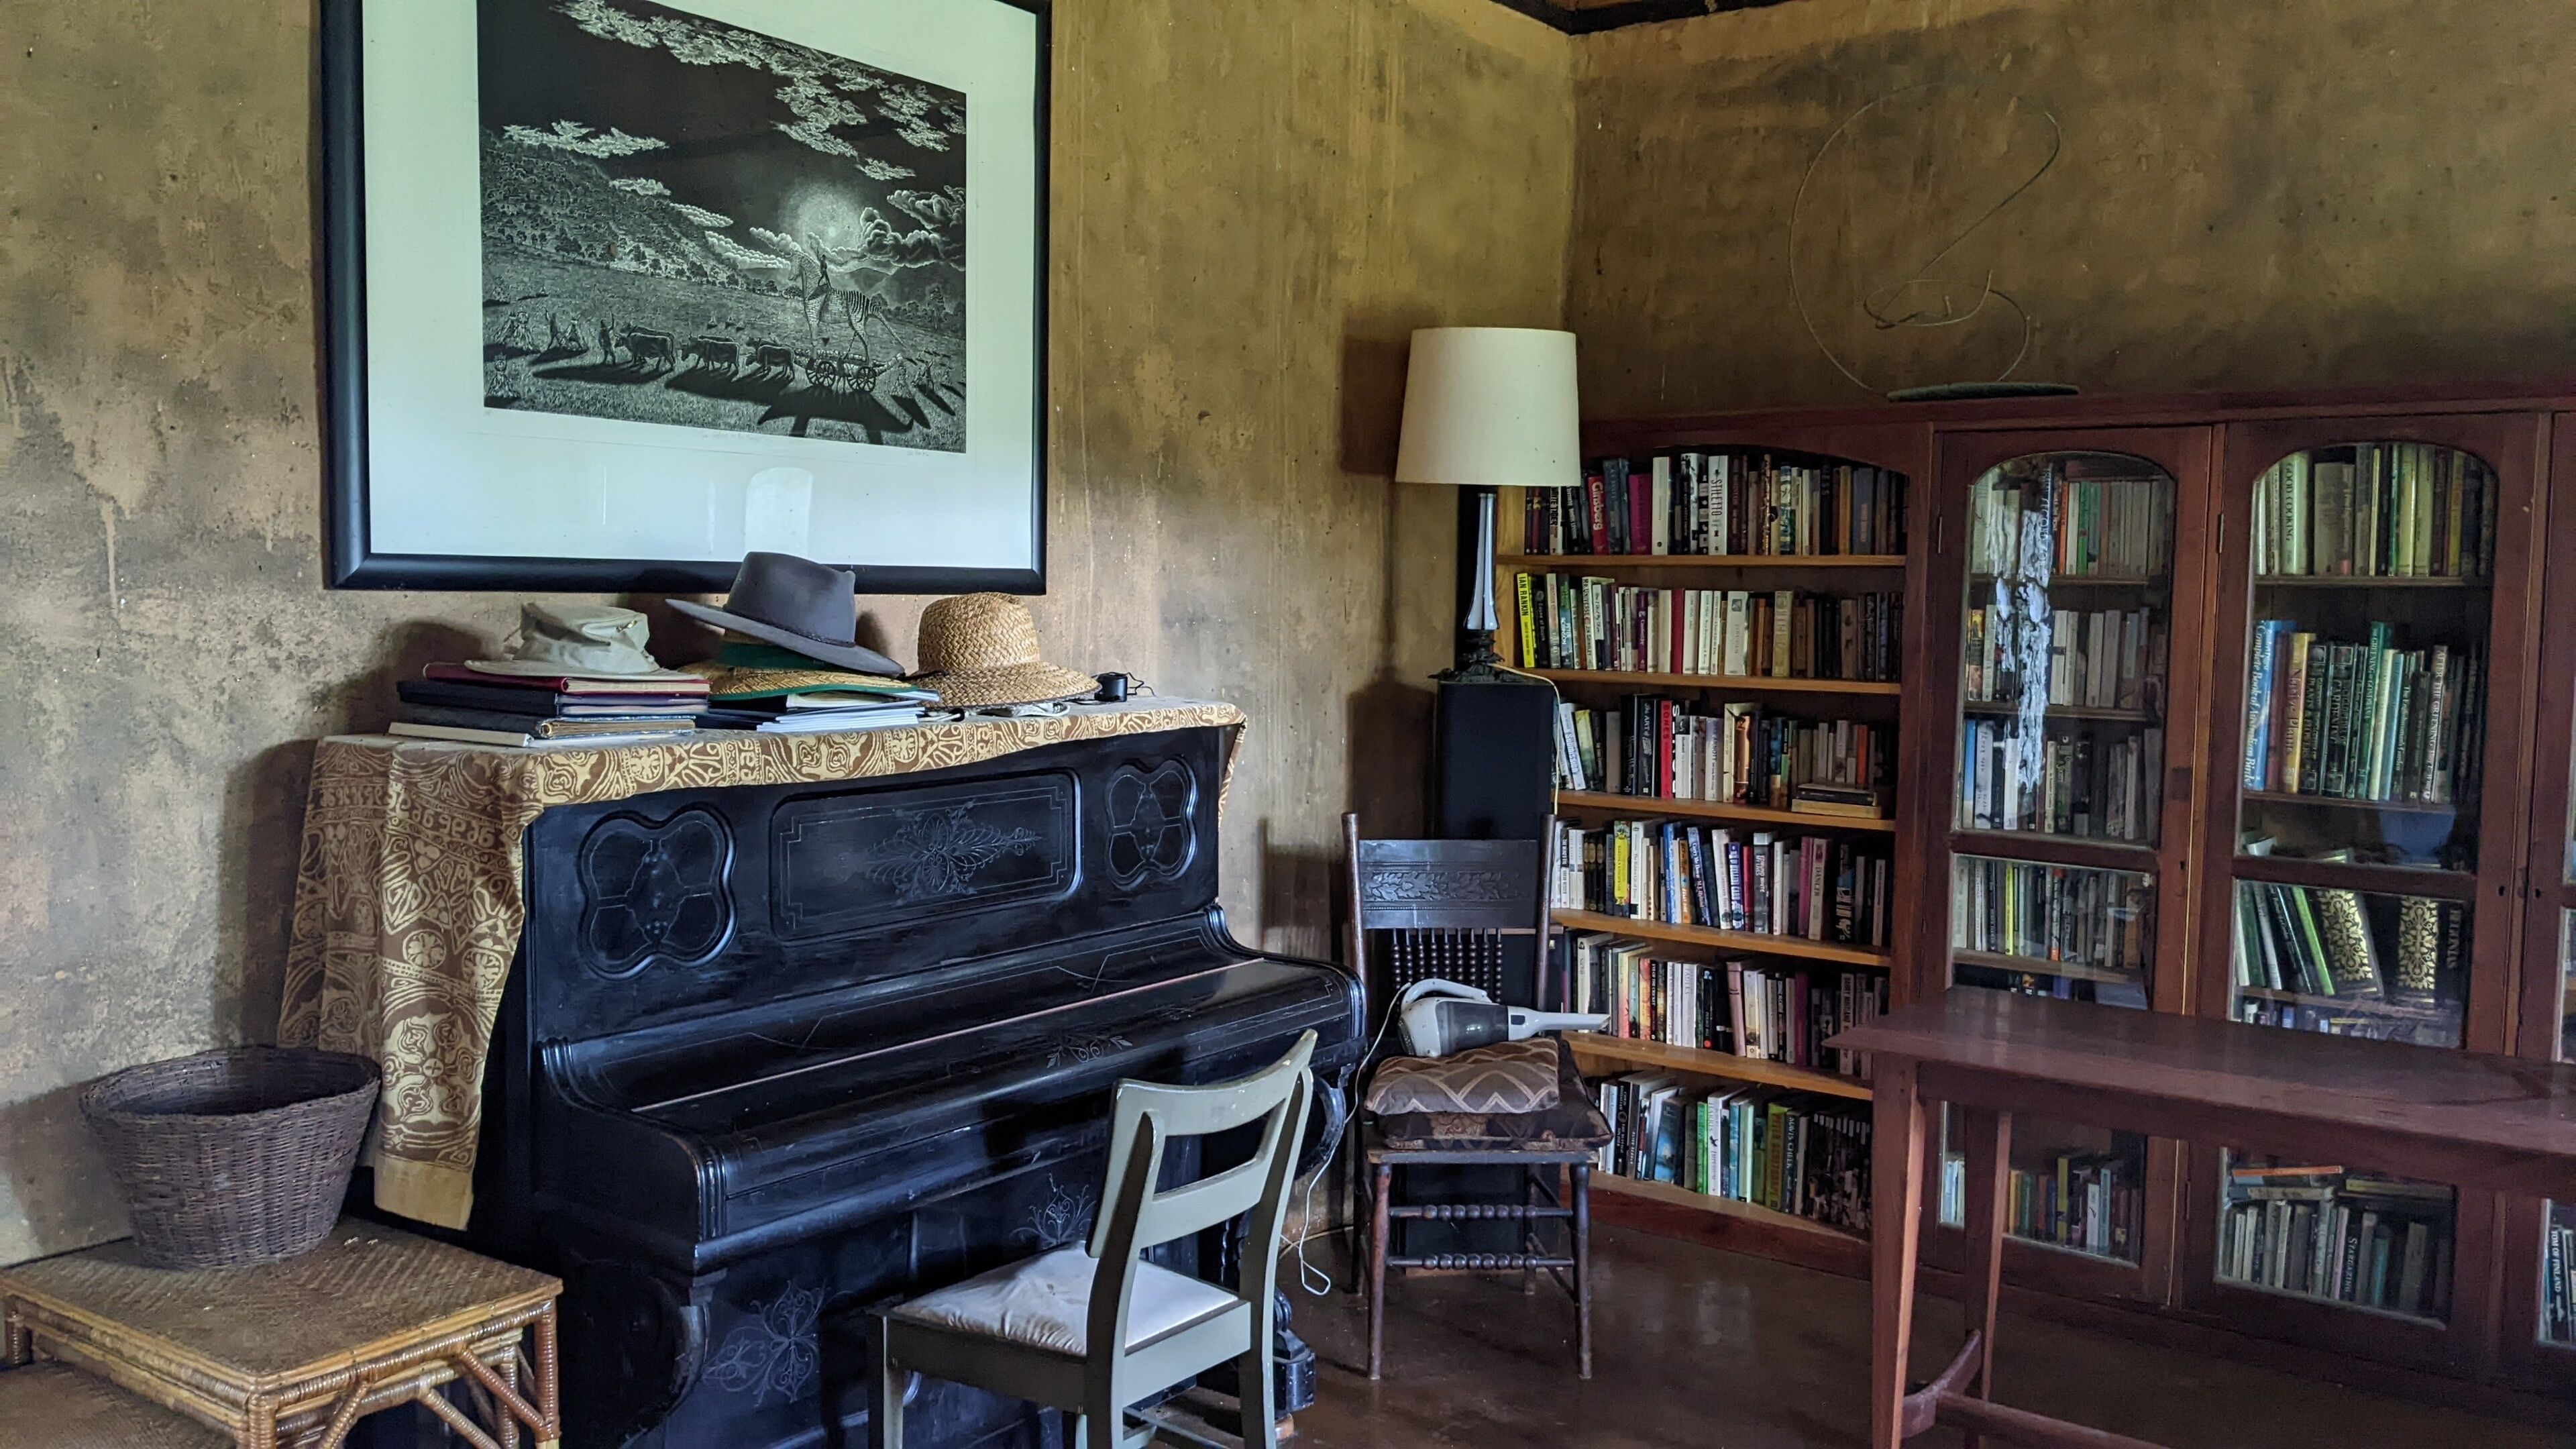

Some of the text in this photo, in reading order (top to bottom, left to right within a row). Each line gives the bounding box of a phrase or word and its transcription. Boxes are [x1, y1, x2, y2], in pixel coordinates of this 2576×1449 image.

[1592, 482, 1604, 530] Ginsberg
[1711, 479, 1723, 516] STILETTO
[1520, 590, 1529, 616] RANKIN
[2368, 638, 2377, 673] GREENING
[2436, 651, 2445, 678] AFTER
[2244, 625, 2265, 782] Complete Book of Australian Birds
[2290, 668, 2301, 712] Native
[2433, 682, 2442, 698] THE
[2286, 718, 2298, 756] Plants
[2429, 701, 2440, 746] GREENING
[1564, 732, 1578, 773] Submission
[1814, 867, 1822, 896] DANCER
[2345, 1238, 2357, 1292] STARGAZING
[2552, 1248, 2559, 1256] OF
[2552, 1259, 2561, 1293] FINLAND
